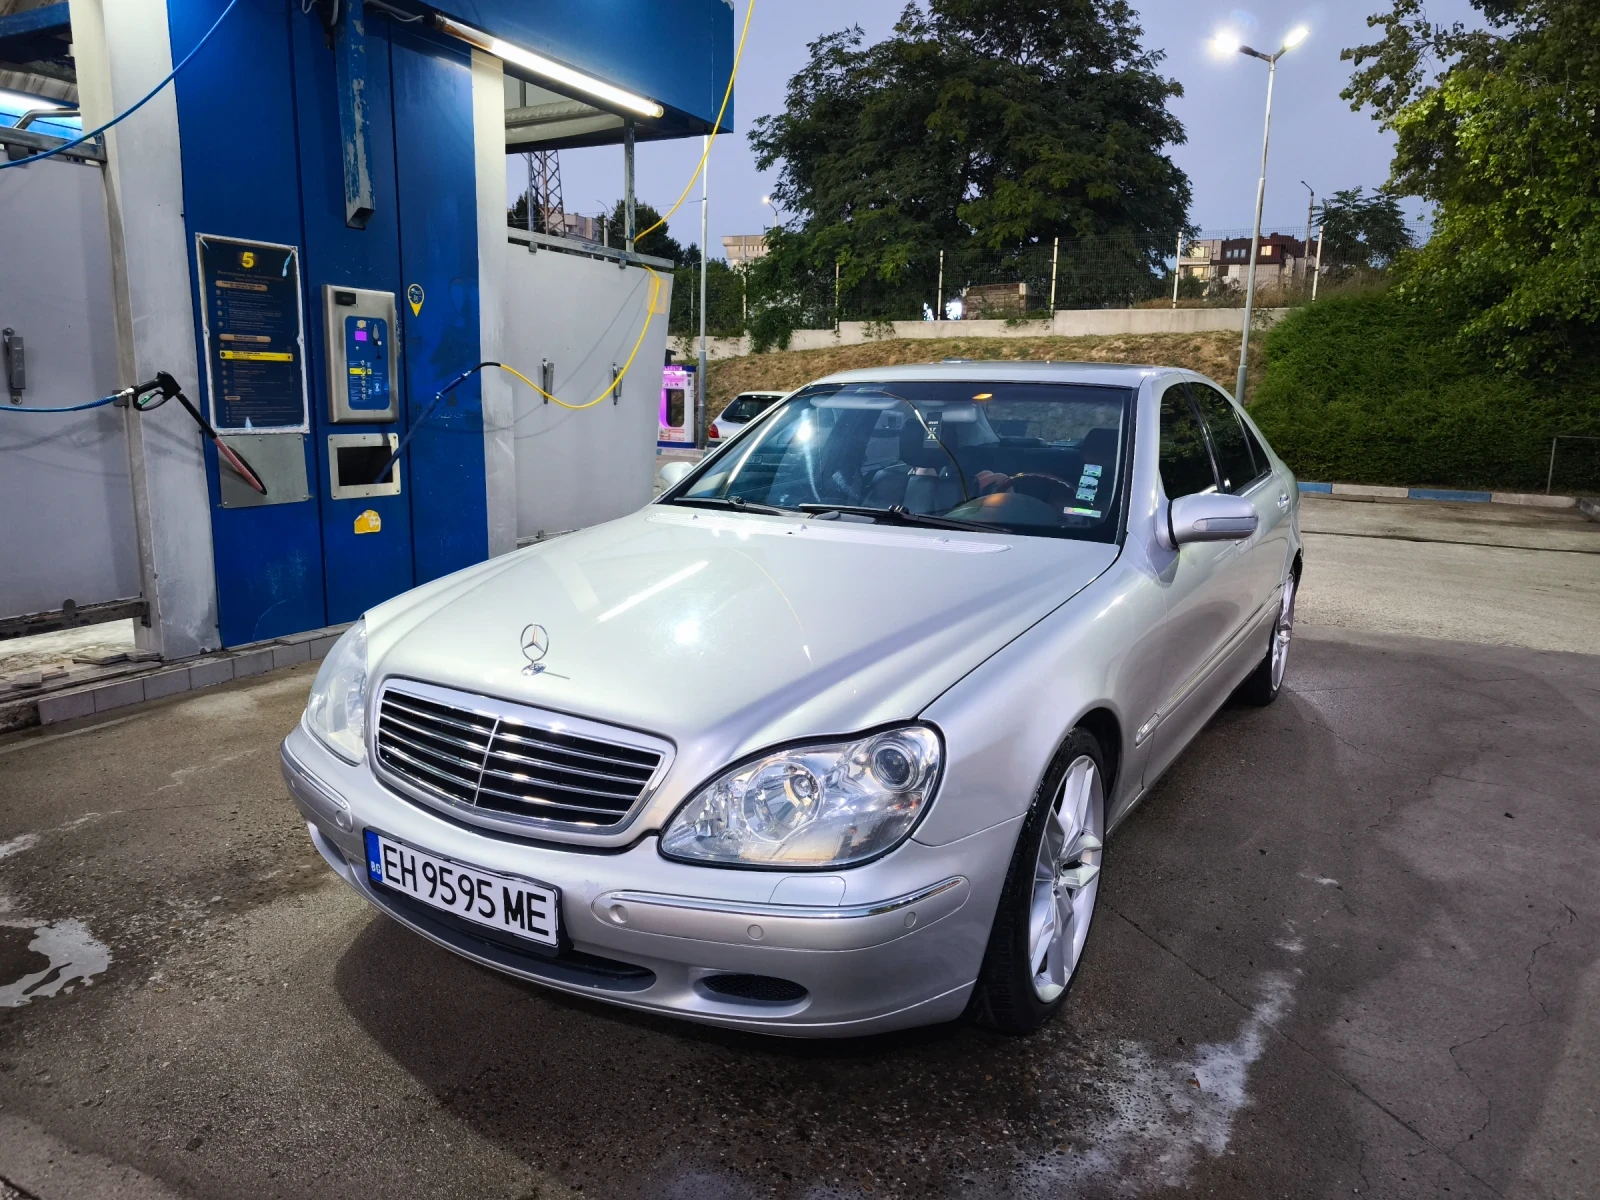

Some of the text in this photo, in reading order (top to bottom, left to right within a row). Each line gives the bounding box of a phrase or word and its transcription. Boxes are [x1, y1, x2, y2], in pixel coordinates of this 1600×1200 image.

[242, 252, 254, 268] 5
[370, 861, 382, 875] BG
[383, 843, 550, 937] EH 9595 ME
